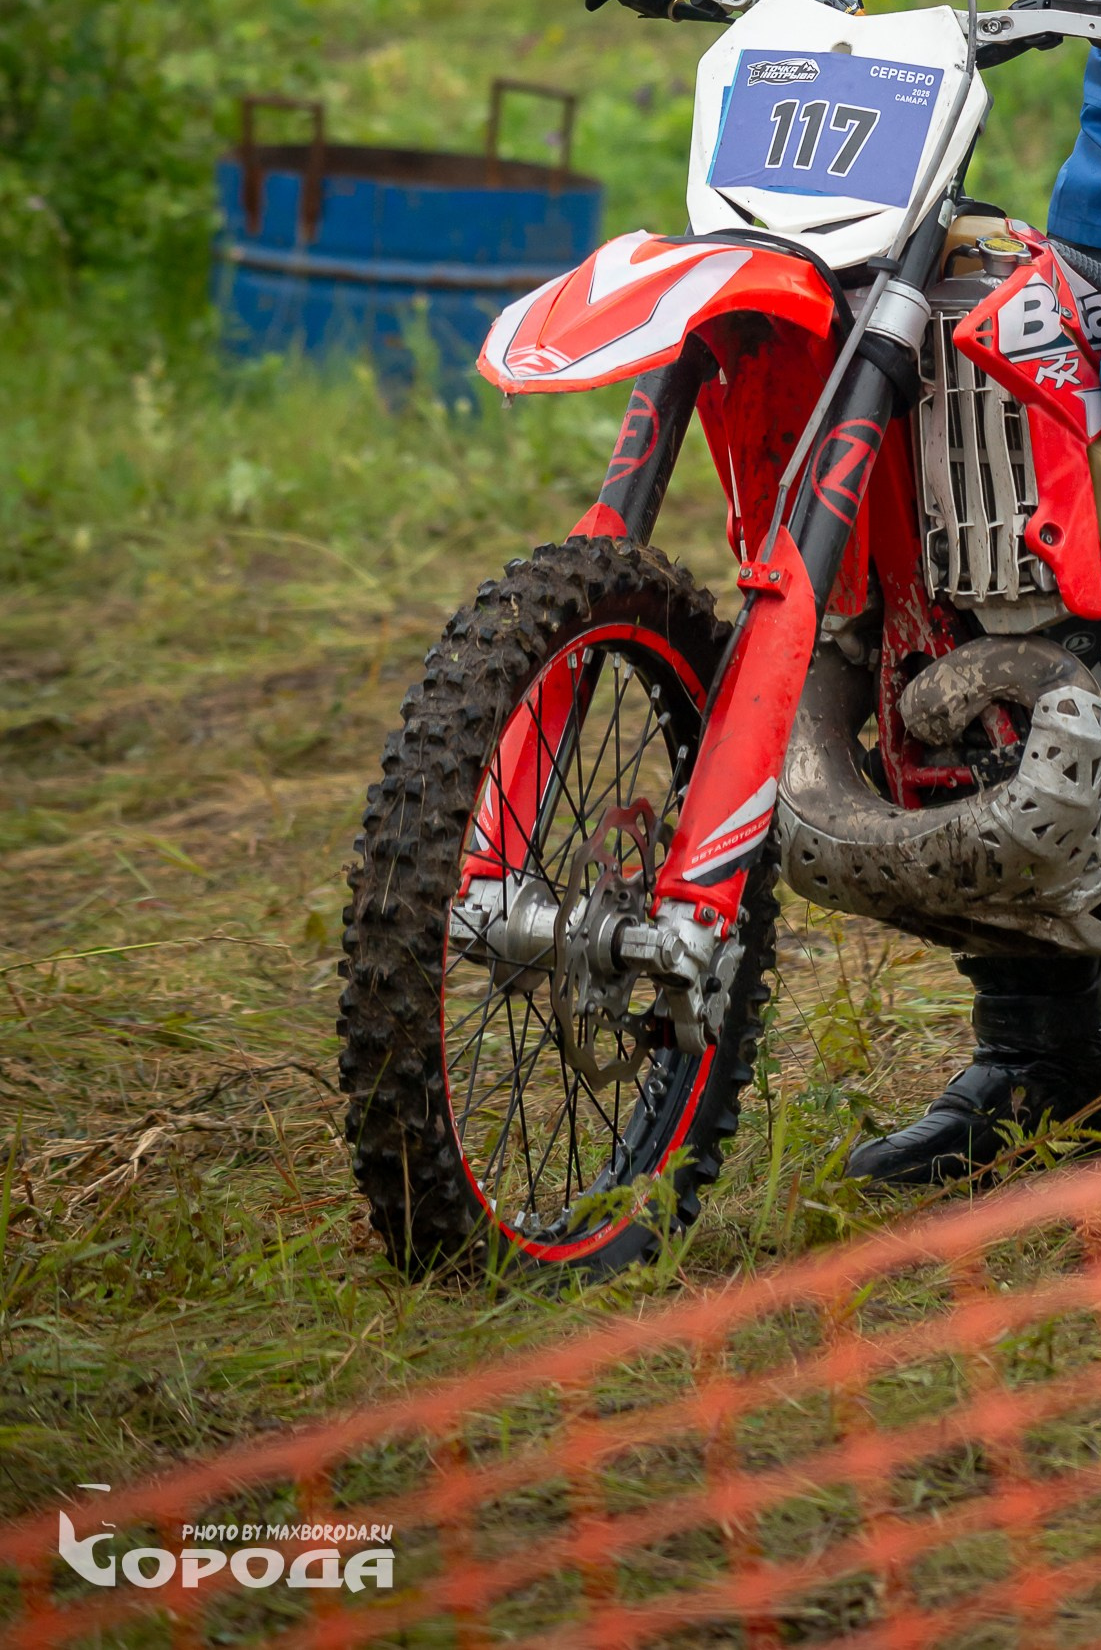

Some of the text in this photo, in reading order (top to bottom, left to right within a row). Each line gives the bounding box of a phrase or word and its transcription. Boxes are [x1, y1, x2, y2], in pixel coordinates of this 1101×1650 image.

[870, 65, 935, 87] СЕРЕБРО
[895, 93, 928, 107] САМАРА
[912, 88, 931, 98] 2025
[765, 99, 881, 177] 117
